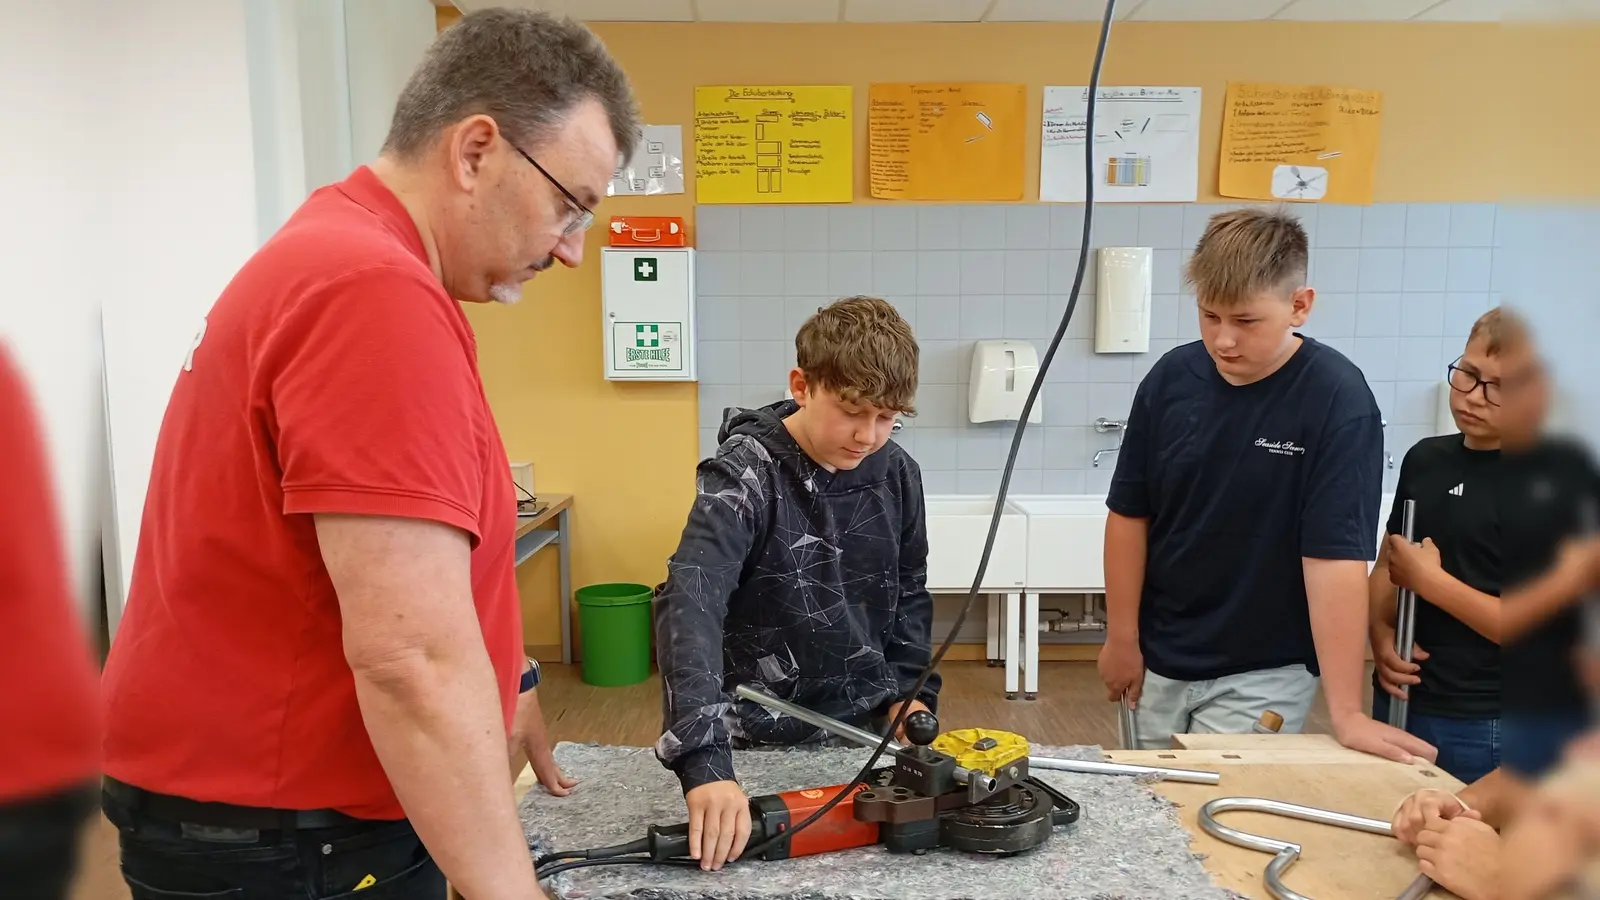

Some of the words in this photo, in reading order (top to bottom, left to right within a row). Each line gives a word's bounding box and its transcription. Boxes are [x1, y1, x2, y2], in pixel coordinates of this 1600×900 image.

[626, 347, 649, 362] ERSTE
[650, 347, 670, 362] HILFE
[1254, 437, 1281, 449] Seaside
